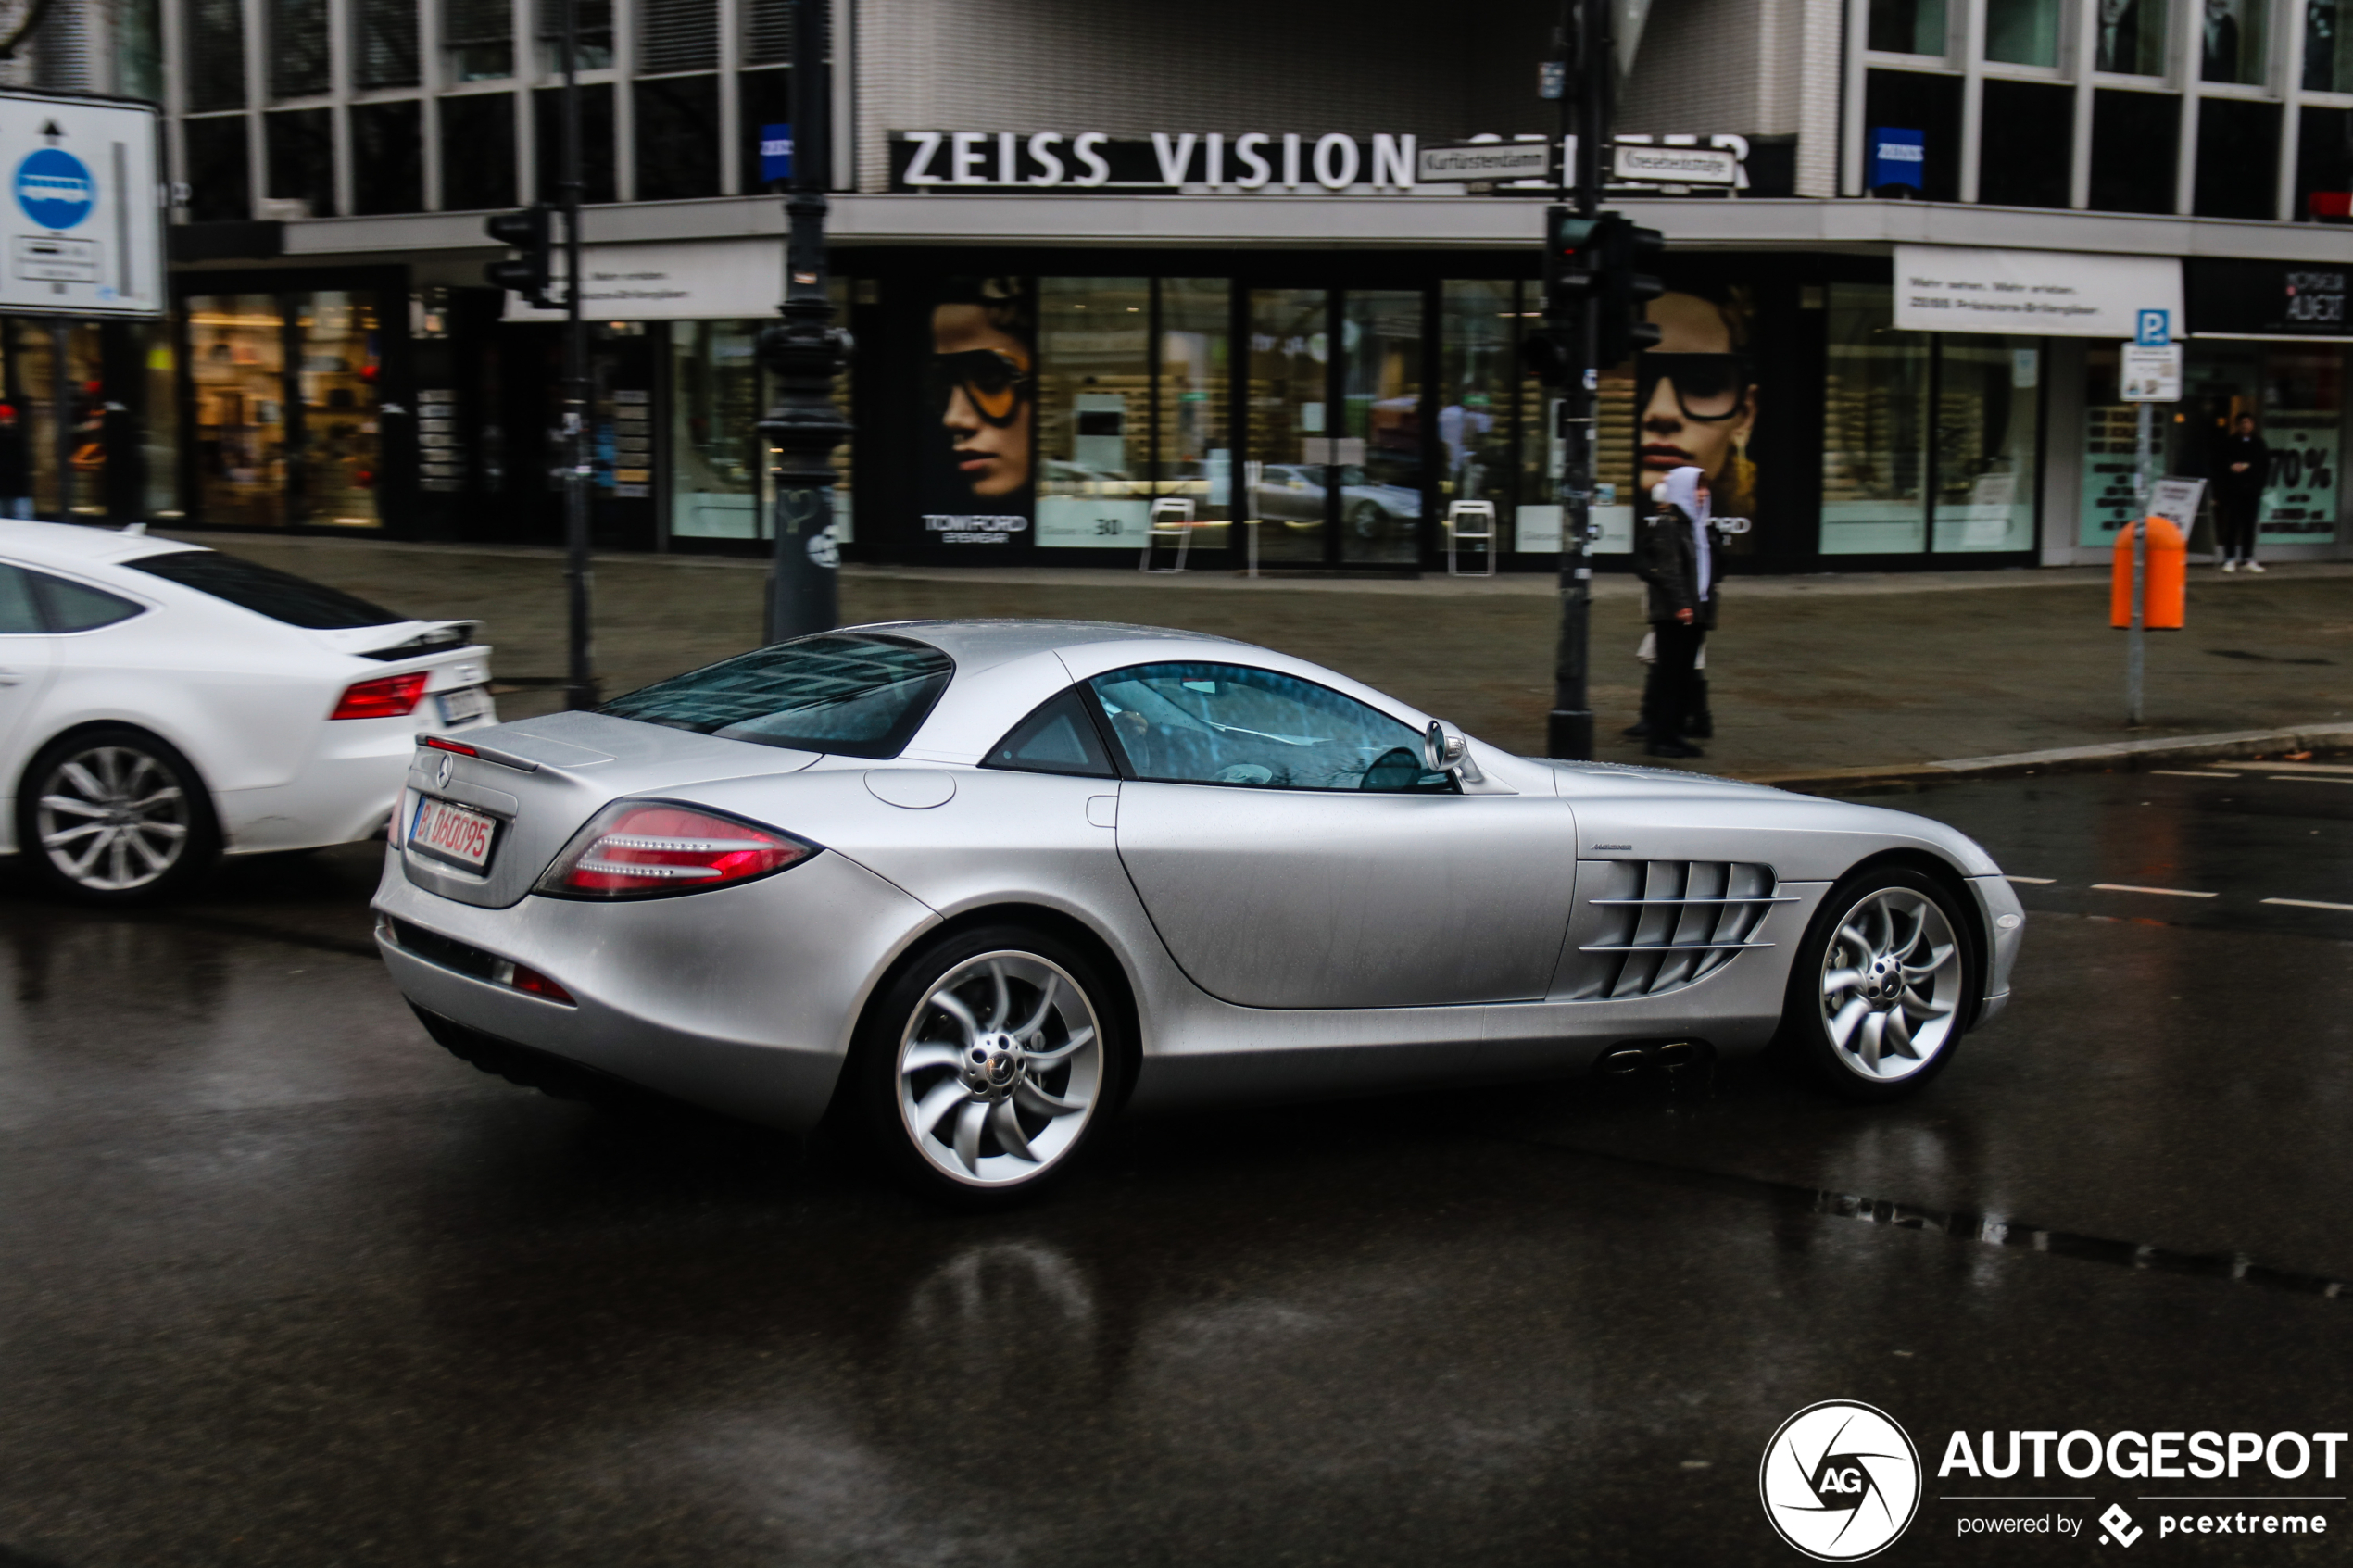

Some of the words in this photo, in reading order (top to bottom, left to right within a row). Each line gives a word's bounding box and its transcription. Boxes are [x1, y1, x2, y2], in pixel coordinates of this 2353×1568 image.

[903, 132, 1111, 187] ZEISS
[1151, 132, 1416, 187] VISION
[1426, 151, 1544, 170] Kurfürstendamm
[921, 514, 971, 531] TOM
[970, 514, 1028, 533] FORD
[417, 803, 431, 837] B
[431, 809, 490, 858] 060095
